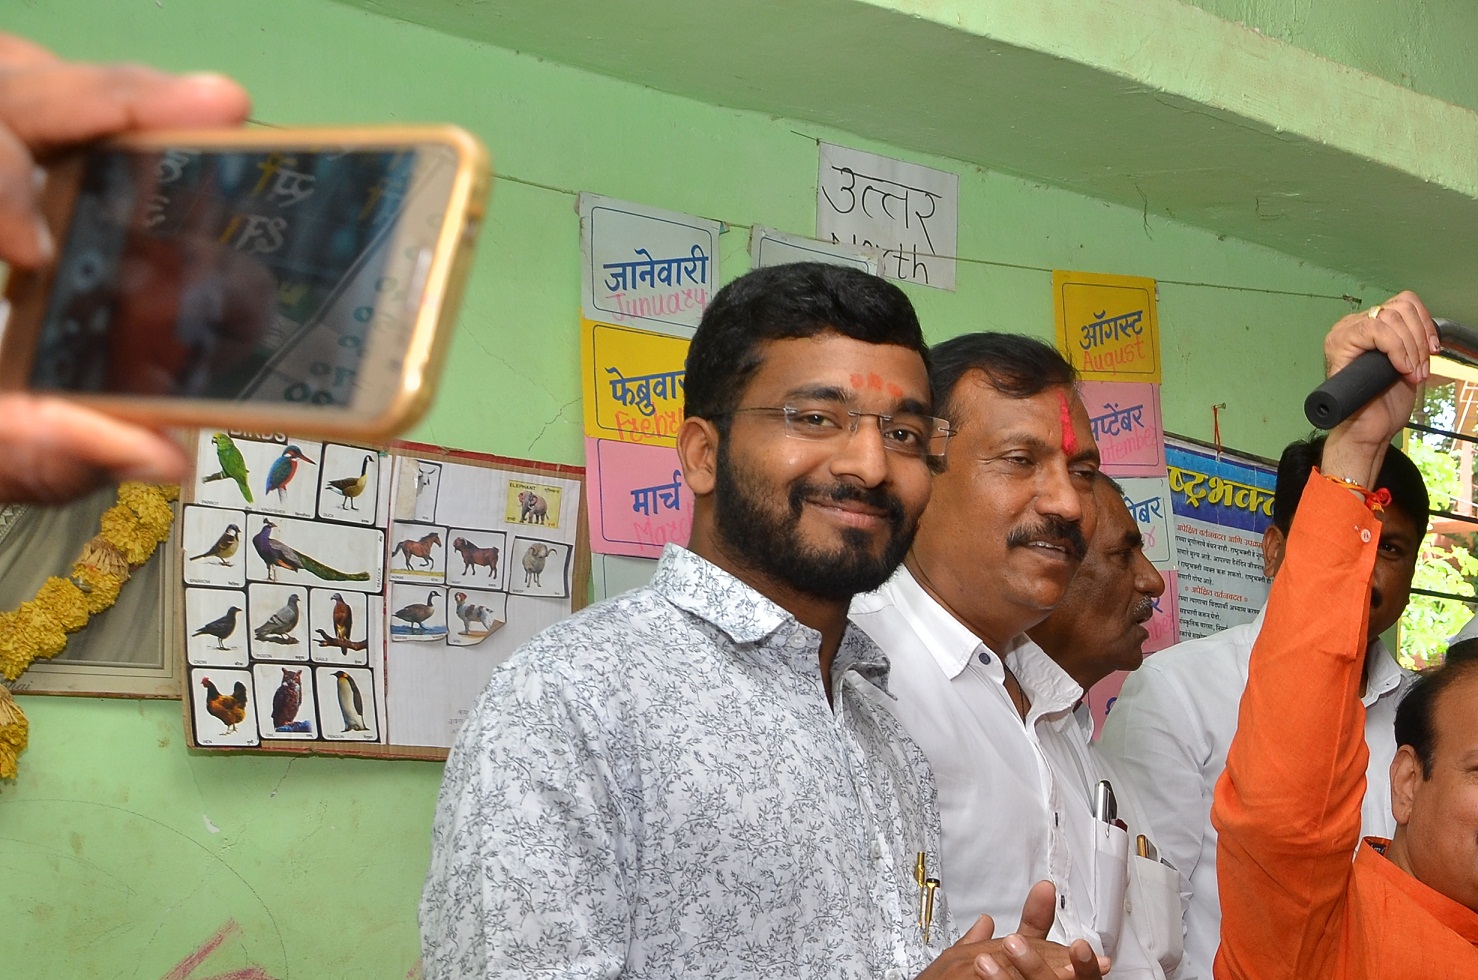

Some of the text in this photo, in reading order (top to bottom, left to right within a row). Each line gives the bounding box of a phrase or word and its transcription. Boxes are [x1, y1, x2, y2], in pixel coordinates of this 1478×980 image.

[821, 165, 942, 255] उत्तर
[602, 244, 709, 291] जानेवारी
[1079, 309, 1143, 351] ऑगस्ट
[1083, 334, 1146, 377] August
[604, 360, 687, 417] फेब्रुवा
[509, 482, 536, 491] ELEPHANT
[631, 469, 682, 516] मार्च
